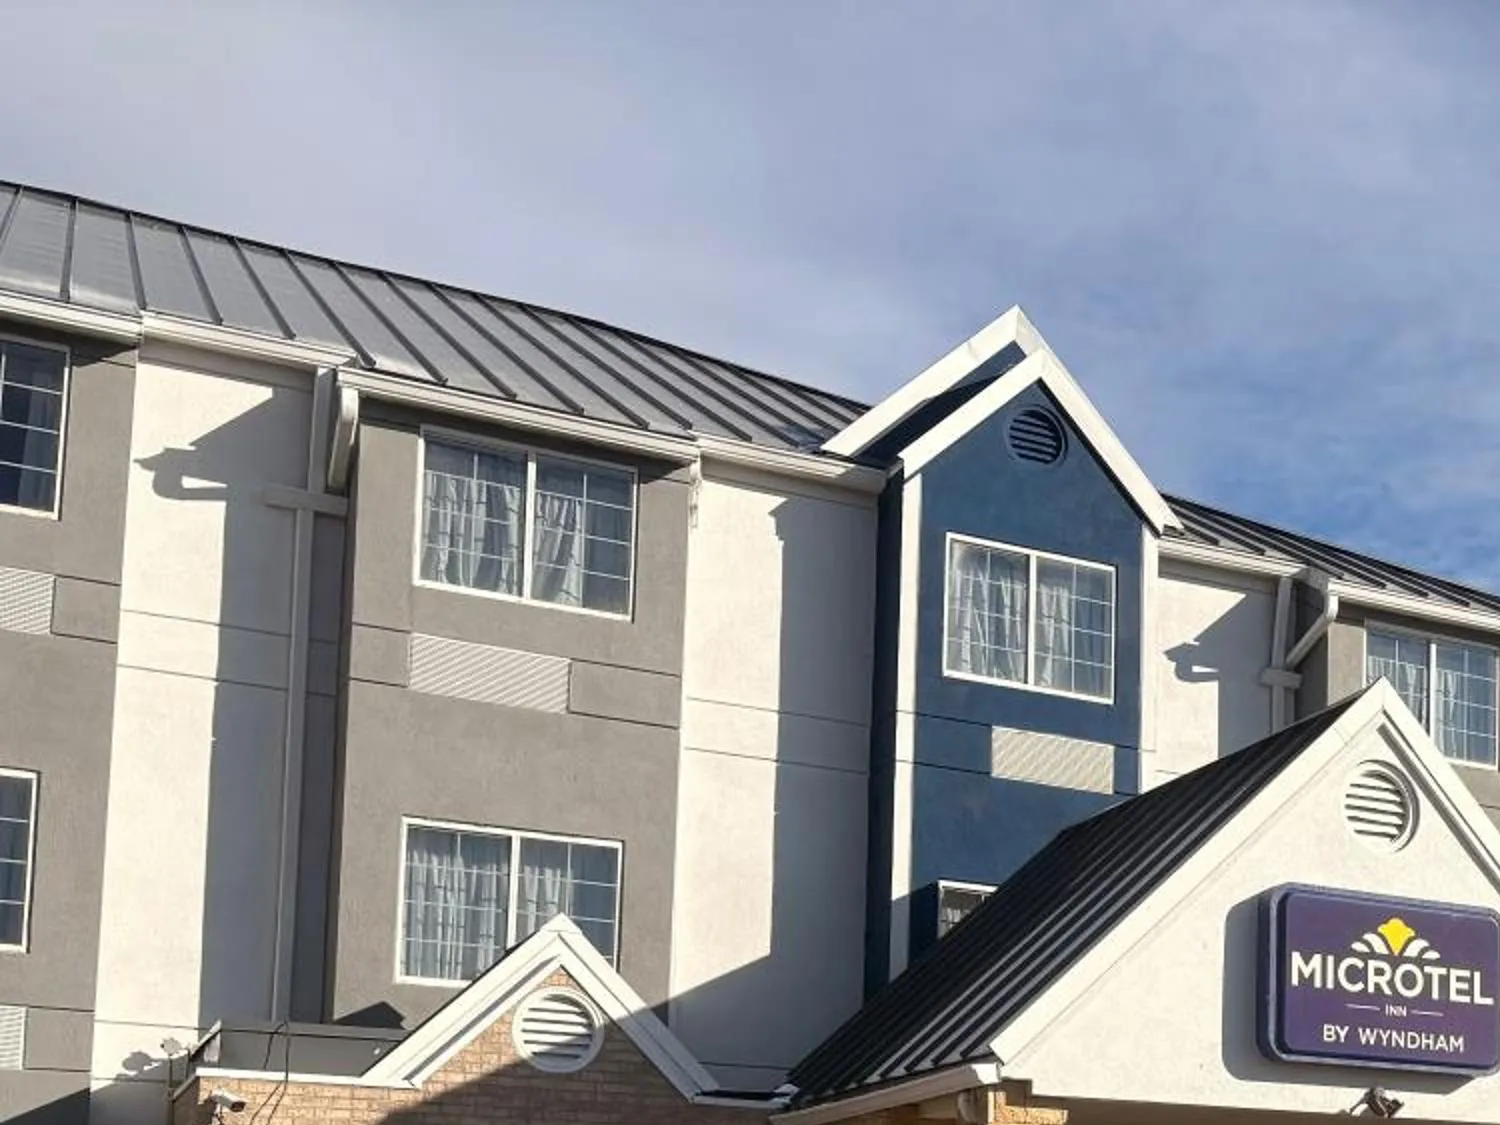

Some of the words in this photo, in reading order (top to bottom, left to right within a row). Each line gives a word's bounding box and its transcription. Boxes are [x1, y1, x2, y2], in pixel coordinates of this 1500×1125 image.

[1290, 951, 1494, 1005] MICROTEL
[1385, 1004, 1407, 1017] INN
[1323, 1023, 1349, 1043] BY
[1358, 1027, 1465, 1053] WYNDHAM
